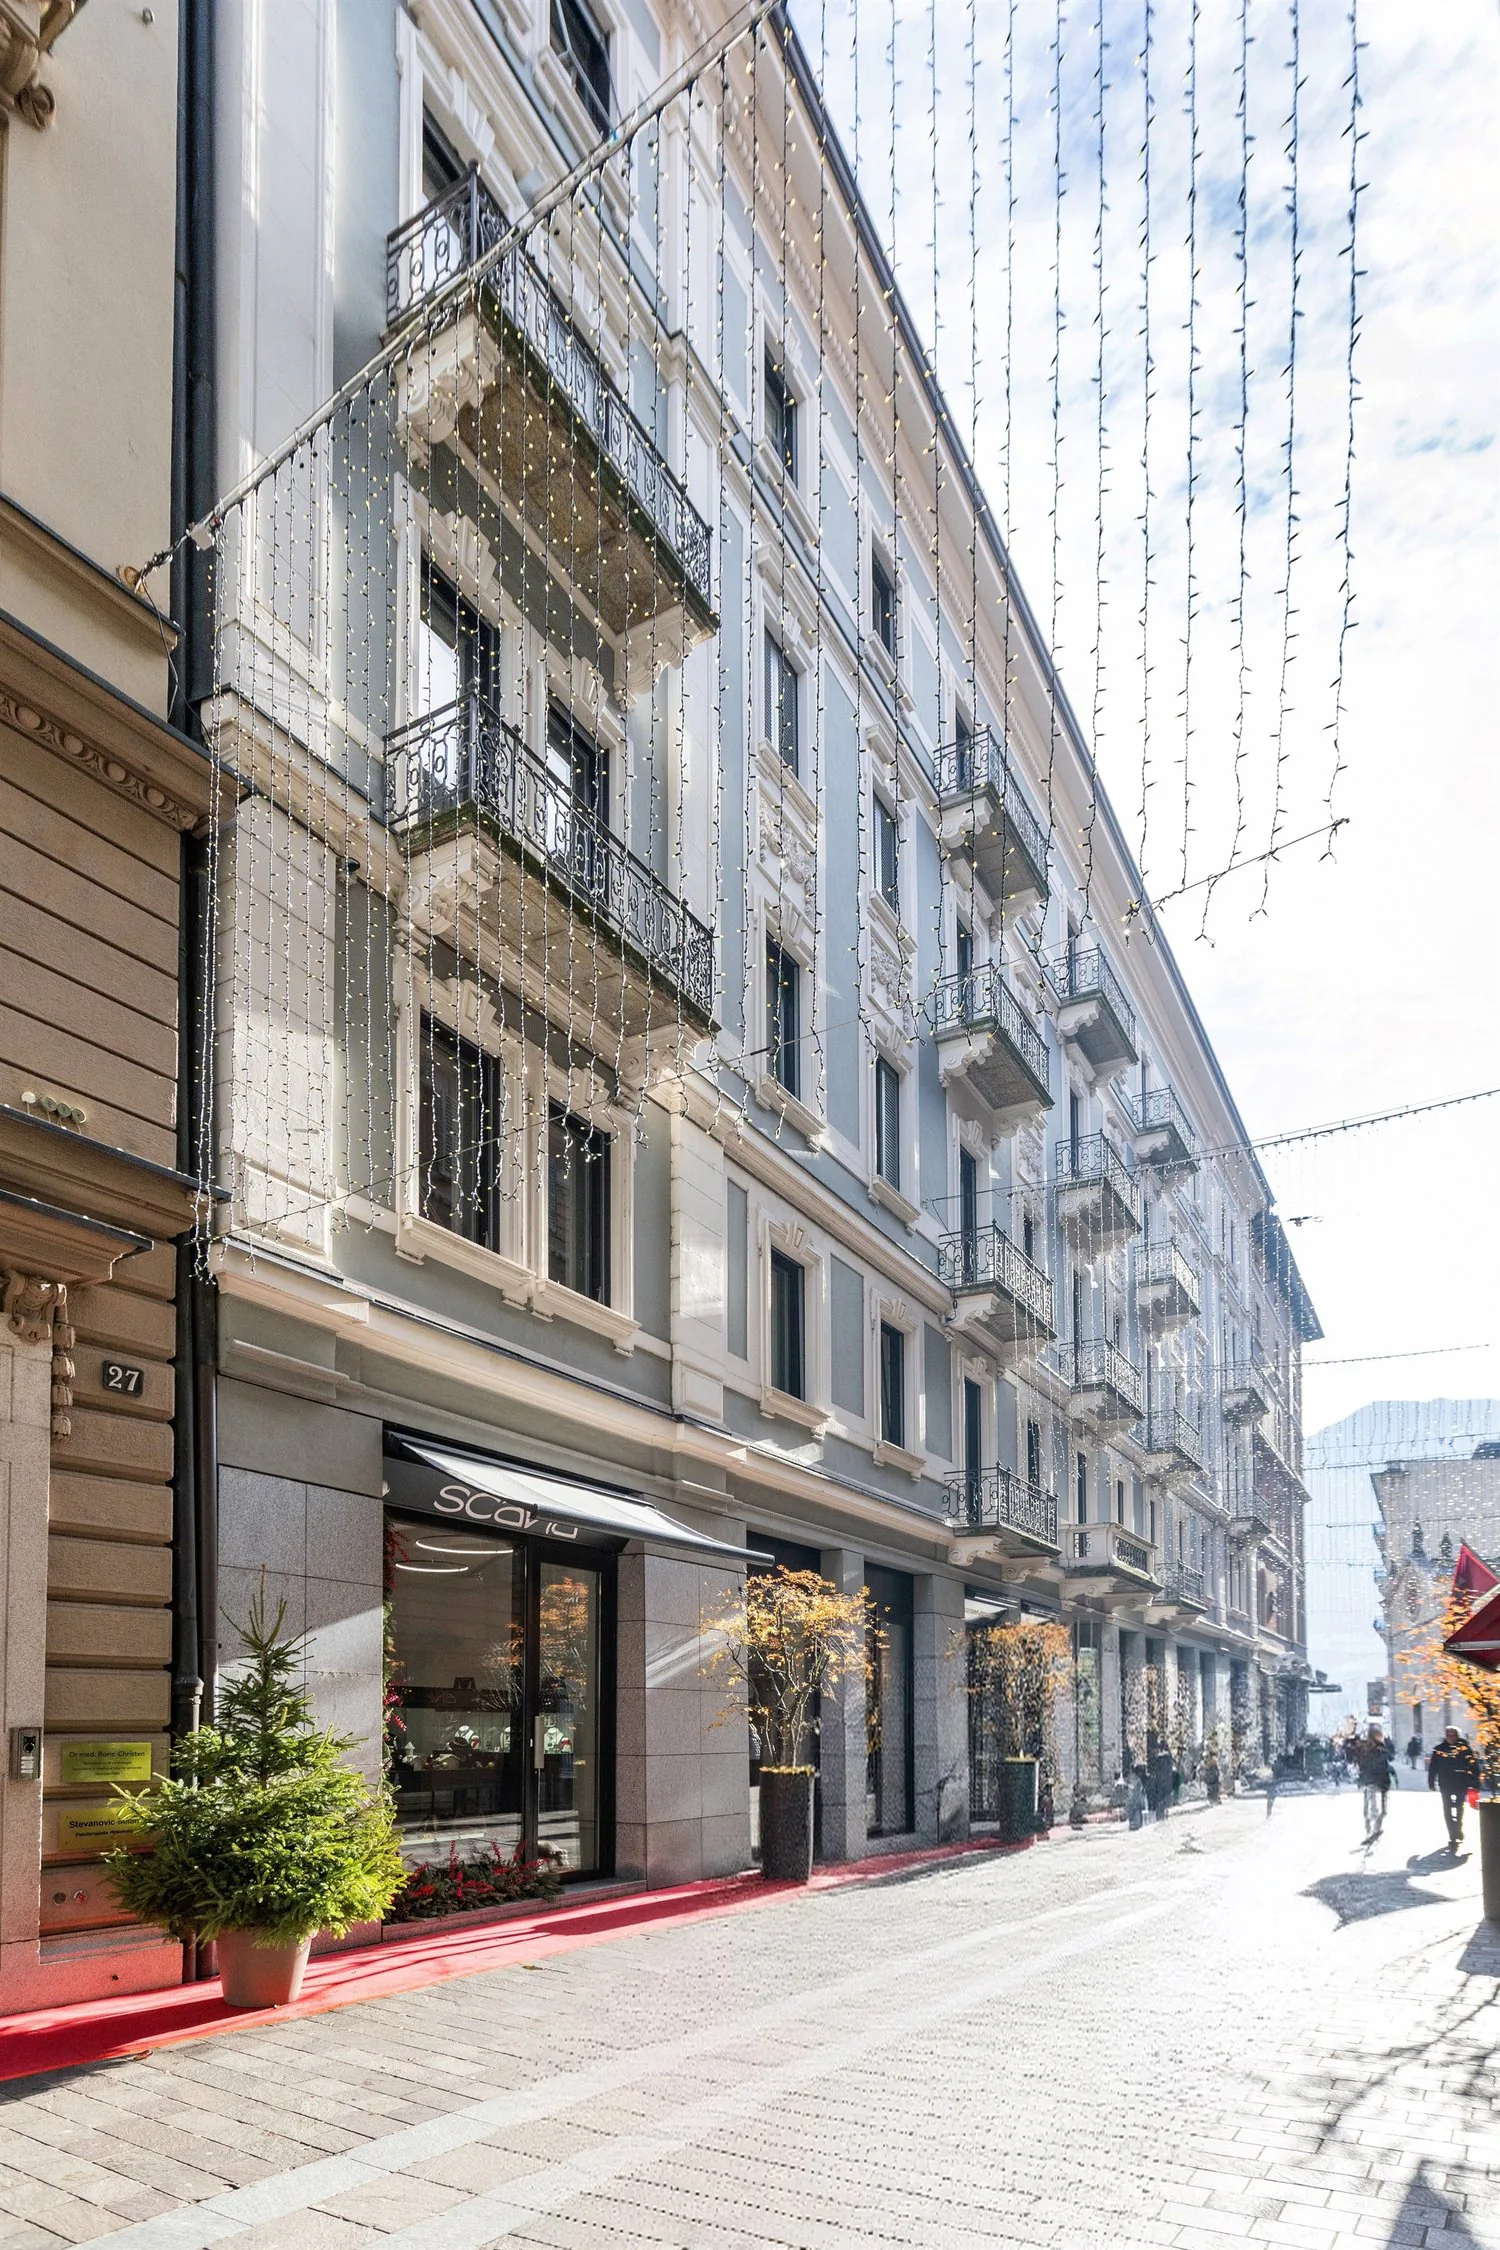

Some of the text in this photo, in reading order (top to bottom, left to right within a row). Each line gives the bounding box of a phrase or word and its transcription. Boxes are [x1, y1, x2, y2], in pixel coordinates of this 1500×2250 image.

[108, 1365, 140, 1392] 27
[97, 1750, 116, 1758] Boris
[117, 1750, 146, 1758] Christen
[69, 1819, 115, 1829] Stevanovic
